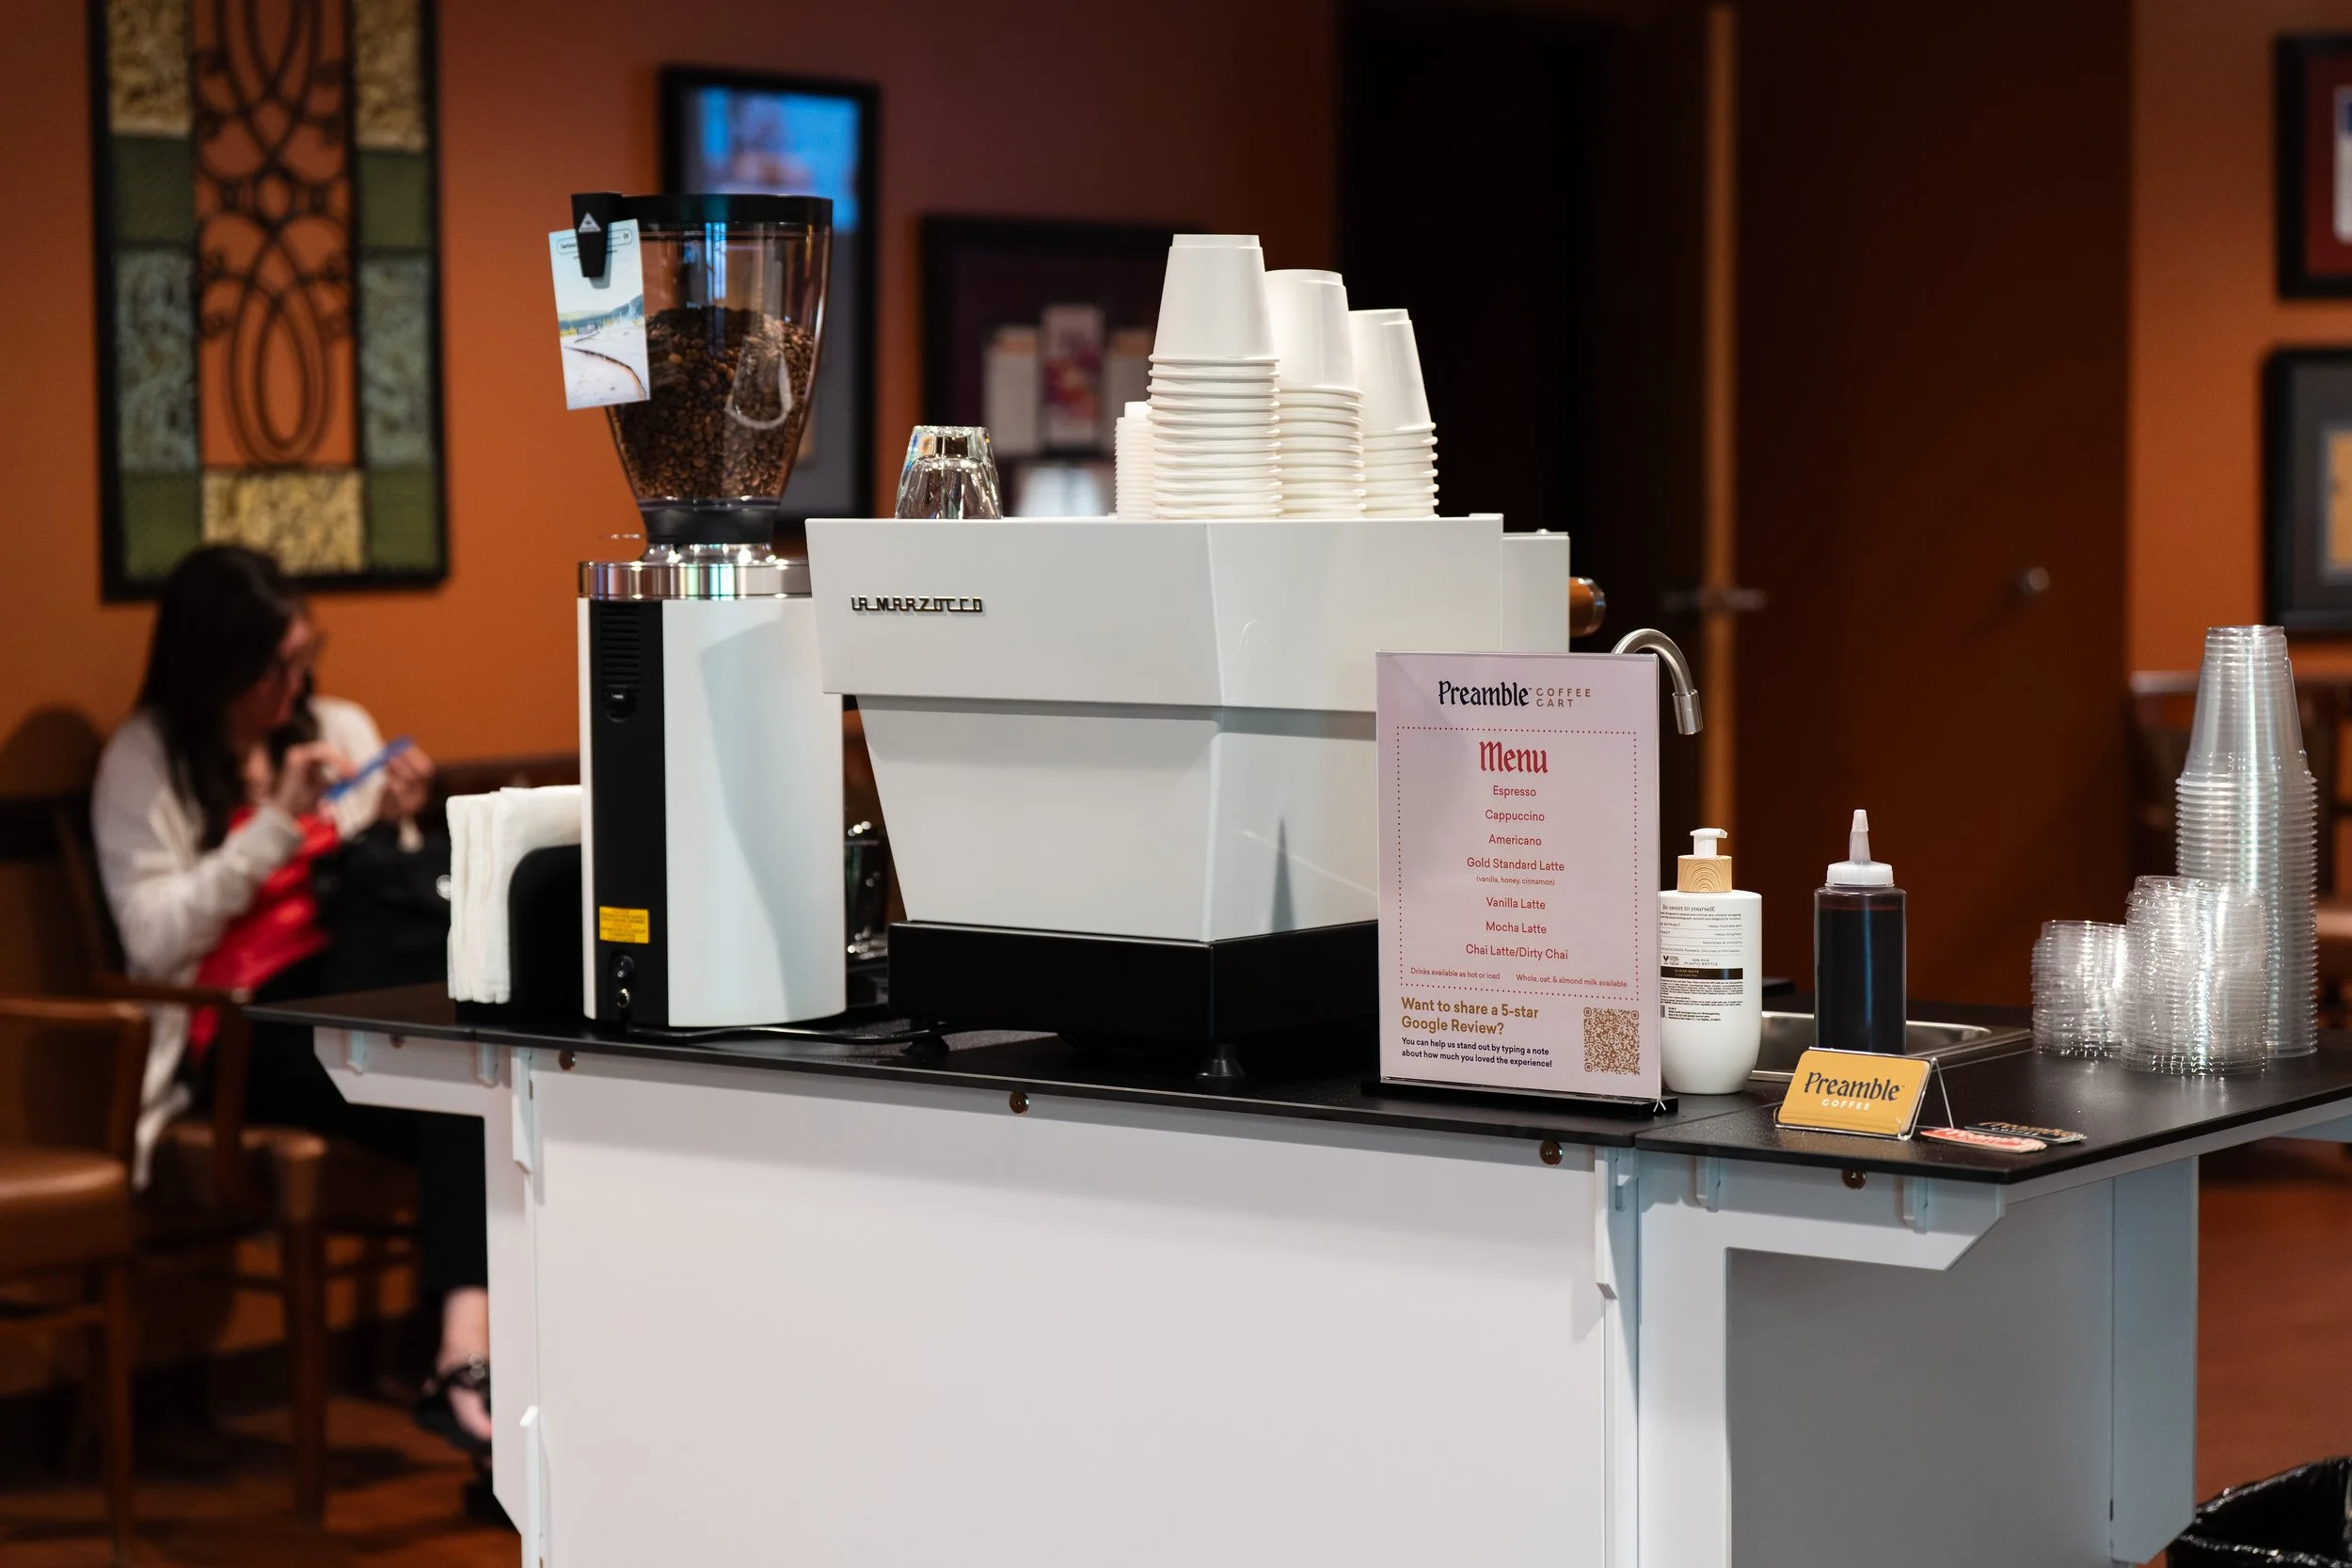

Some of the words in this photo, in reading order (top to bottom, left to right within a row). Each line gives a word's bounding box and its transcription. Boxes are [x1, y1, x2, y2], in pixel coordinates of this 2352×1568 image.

[1438, 680, 1529, 706] Preamble
[1536, 688, 1591, 698] COFFEE
[1536, 699, 1573, 707] CART
[1479, 740, 1549, 773] Menu
[1493, 784, 1537, 798] Espresso
[1485, 809, 1545, 823] Cappuccino
[1488, 833, 1542, 847] Americano
[1467, 857, 1490, 868] Gold
[1493, 858, 1537, 871] Standard
[1539, 860, 1565, 872] Latte
[1476, 876, 1500, 884] (vanilla,
[1521, 877, 1555, 887] cinnamon)
[1486, 896, 1518, 909] Vanilla
[1520, 898, 1546, 911] Latte
[1486, 921, 1519, 933] Mocha
[1521, 923, 1547, 934] Latte
[1466, 943, 1488, 956] Chai
[1490, 944, 1543, 961] Latte/Dirty
[1545, 948, 1568, 960] Chai
[1411, 967, 1430, 975] Drinks
[1431, 969, 1458, 977] available
[1467, 971, 1478, 979] hot
[1486, 972, 1501, 980] iced
[1516, 974, 1539, 983] Whole,
[1552, 975, 1558, 984] &
[1558, 976, 1583, 986] almond
[1583, 977, 1598, 986] milk
[1598, 979, 1628, 989] available
[1401, 996, 1435, 1012] Want
[1437, 1000, 1451, 1013] to
[1454, 1000, 1488, 1016] share
[1491, 1006, 1499, 1016] a
[1501, 1003, 1539, 1019] 5-star
[1401, 1015, 1449, 1035] Google
[1451, 1019, 1505, 1035] Review?
[1401, 1037, 1415, 1046] You
[1430, 1038, 1446, 1050] help
[1456, 1041, 1477, 1051] stand
[1478, 1043, 1490, 1052] out
[1491, 1042, 1501, 1053] by
[1502, 1044, 1525, 1056] typing
[1532, 1047, 1549, 1056] note
[1401, 1049, 1422, 1058] about
[1423, 1050, 1438, 1059] how
[1439, 1051, 1460, 1061] much
[1460, 1054, 1475, 1064] you
[1475, 1053, 1496, 1064] loved
[1496, 1055, 1509, 1065] the
[1509, 1058, 1553, 1069] experience!
[1804, 1071, 1901, 1101] Preamble
[1821, 1099, 1871, 1111] COFFEE
